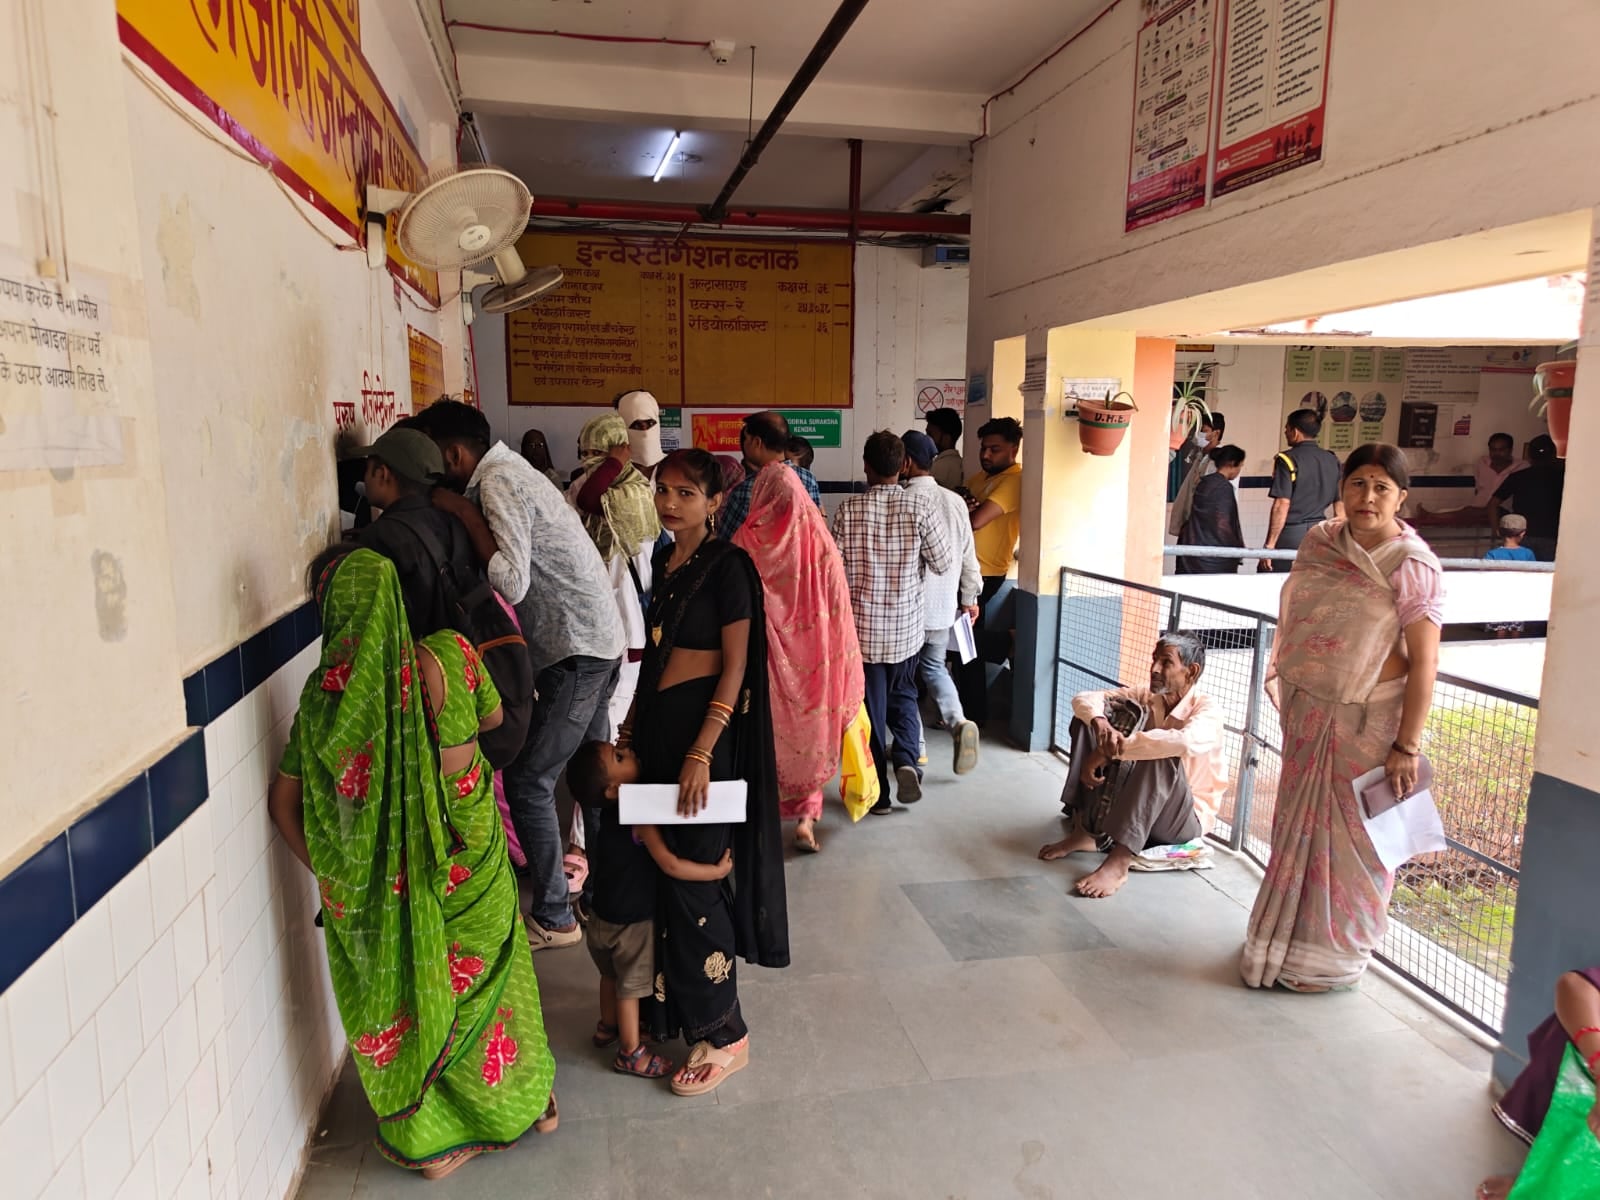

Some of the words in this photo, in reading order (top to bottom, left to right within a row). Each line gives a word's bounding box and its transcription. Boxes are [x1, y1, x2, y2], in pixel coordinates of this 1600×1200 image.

[0, 278, 22, 303] पया
[14, 362, 42, 386] ऊपर
[720, 437, 740, 445] FIRE
